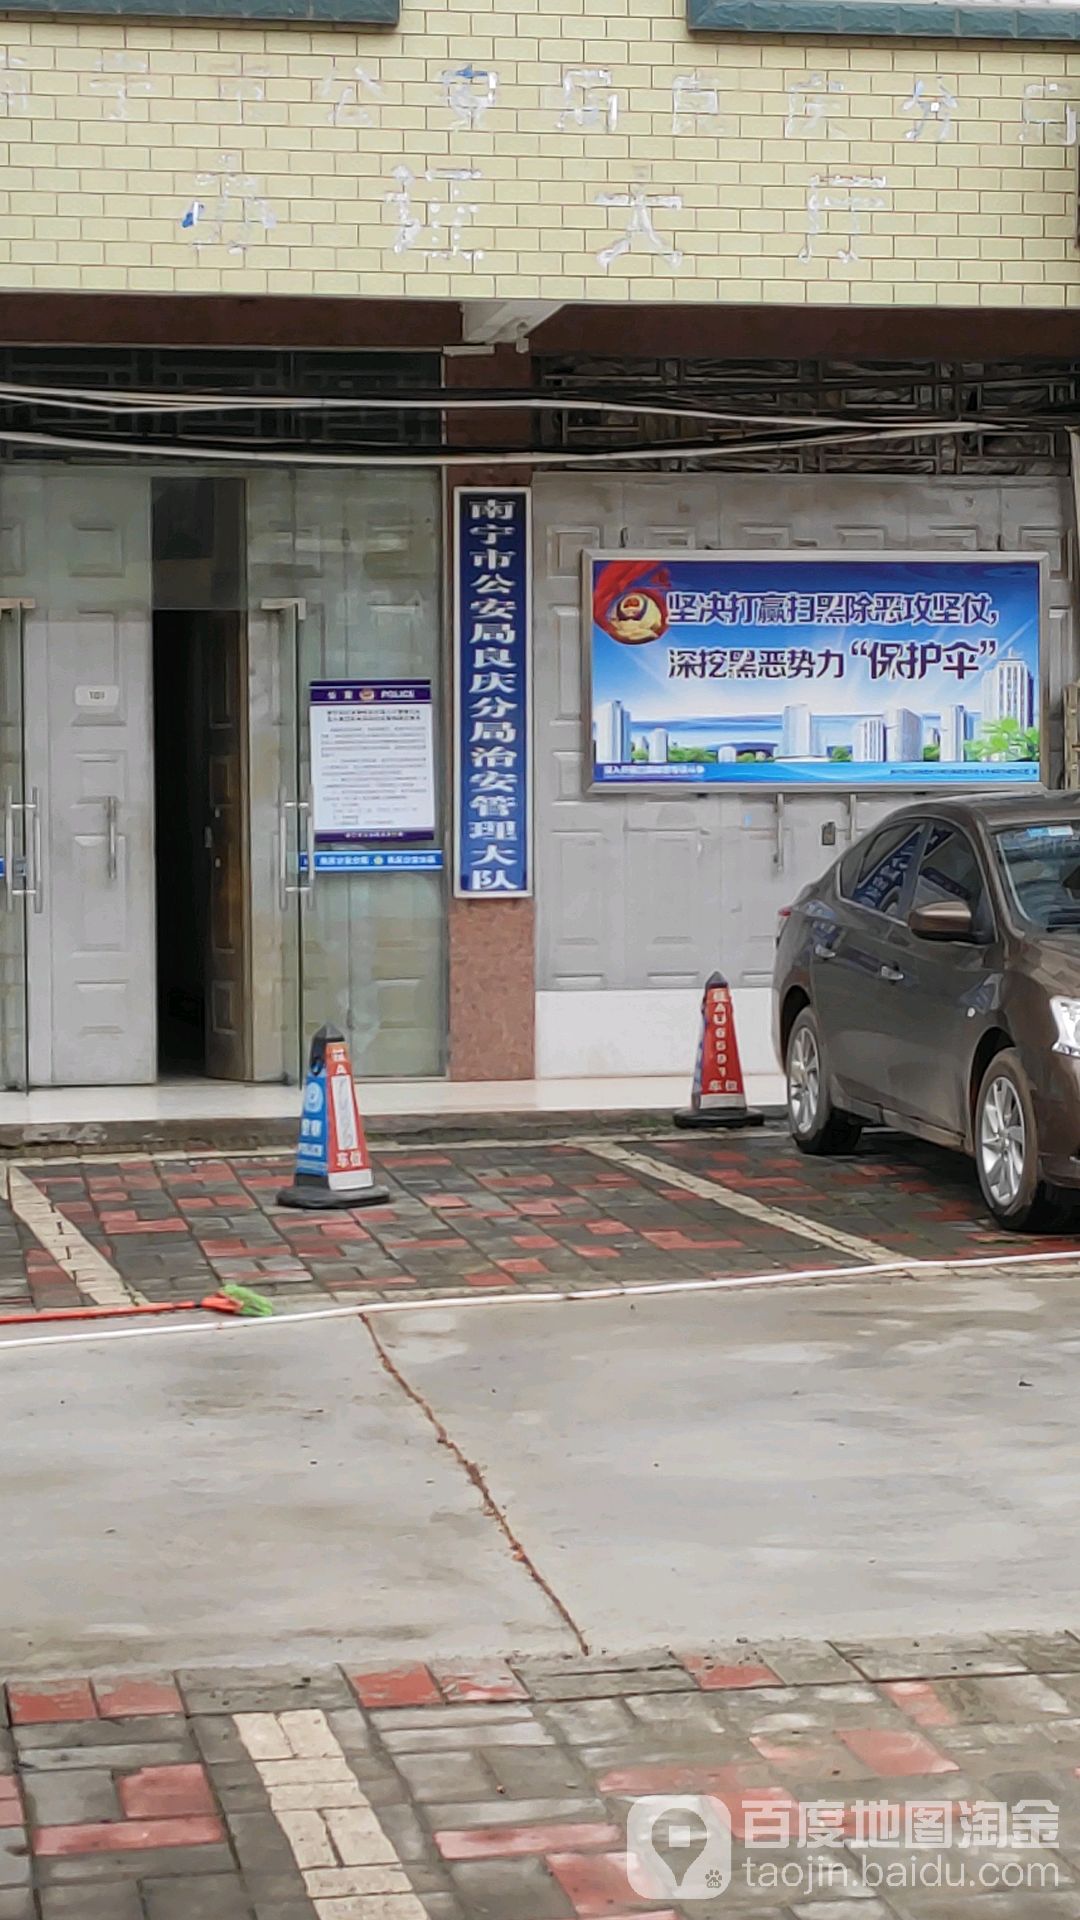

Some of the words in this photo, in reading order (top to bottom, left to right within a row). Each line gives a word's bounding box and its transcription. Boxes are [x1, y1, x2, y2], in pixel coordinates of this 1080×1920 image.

[468, 498, 518, 891] 南宁市公安局良庆分局治安管理大队
